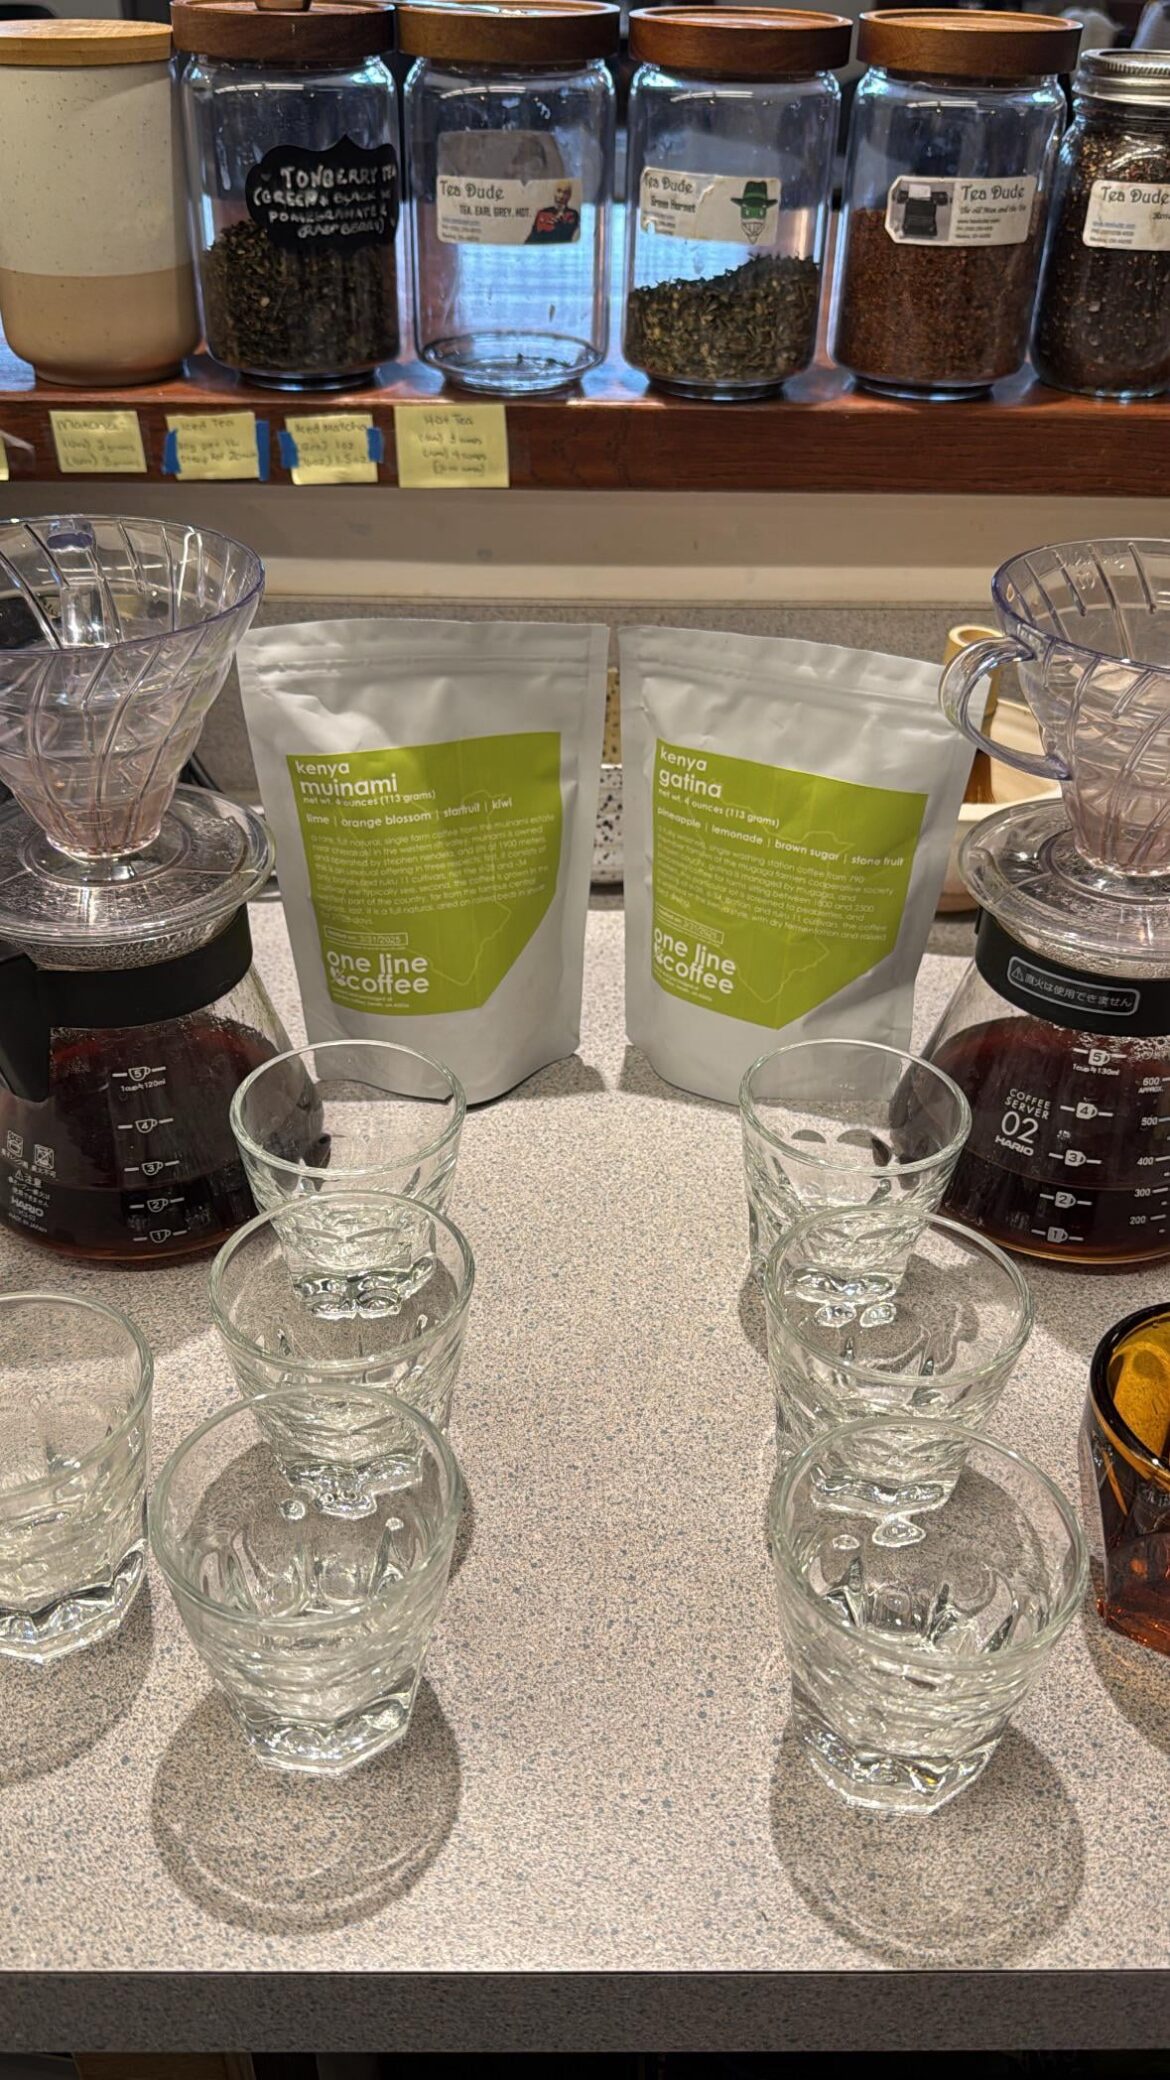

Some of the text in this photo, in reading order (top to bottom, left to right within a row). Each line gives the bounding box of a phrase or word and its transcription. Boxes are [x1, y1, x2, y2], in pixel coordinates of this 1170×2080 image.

[280, 164, 377, 189] TONBERRY
[662, 176, 693, 195] Dude
[440, 180, 505, 201] Tea Dude
[961, 183, 1025, 201] Tea Dude
[1101, 185, 1169, 206] Tea Dude
[474, 205, 492, 217] EARL
[493, 206, 513, 218] GREY.
[659, 747, 708, 772] kenya
[295, 761, 350, 778] kenya
[300, 773, 398, 797] muinami
[659, 768, 723, 799] gatina
[343, 798, 379, 808] ounces
[380, 794, 401, 806] (113
[403, 789, 437, 804] grams)
[306, 798, 513, 829] lime orange blossom starfruit kiwi
[691, 799, 724, 816] ounces
[725, 805, 745, 822] (113
[747, 811, 780, 829] grams)
[657, 806, 904, 867] pineapple lemonade brown sugar stone fruit
[654, 927, 736, 976] one line
[327, 951, 429, 974] one line
[1093, 1052, 1103, 1062] 5
[135, 1070, 142, 1078] 5
[1143, 1077, 1161, 1087] 600
[1004, 1096, 1050, 1120] SERVER
[1009, 1088, 1051, 1110] COFFEE
[1079, 1106, 1090, 1116] 4
[141, 1122, 149, 1130] 4
[1001, 1111, 1039, 1144] 02
[1141, 1117, 1159, 1127] 500
[994, 1134, 1035, 1157] HARIO
[1069, 1153, 1078, 1163] 3
[1137, 1156, 1155, 1166] 400
[146, 1164, 155, 1173] 3
[1058, 1194, 1068, 1205] 2
[1134, 1187, 1151, 1198] 300
[11, 1195, 45, 1217] HARIO
[152, 1201, 160, 1209] 2
[1129, 1215, 1147, 1225] 200
